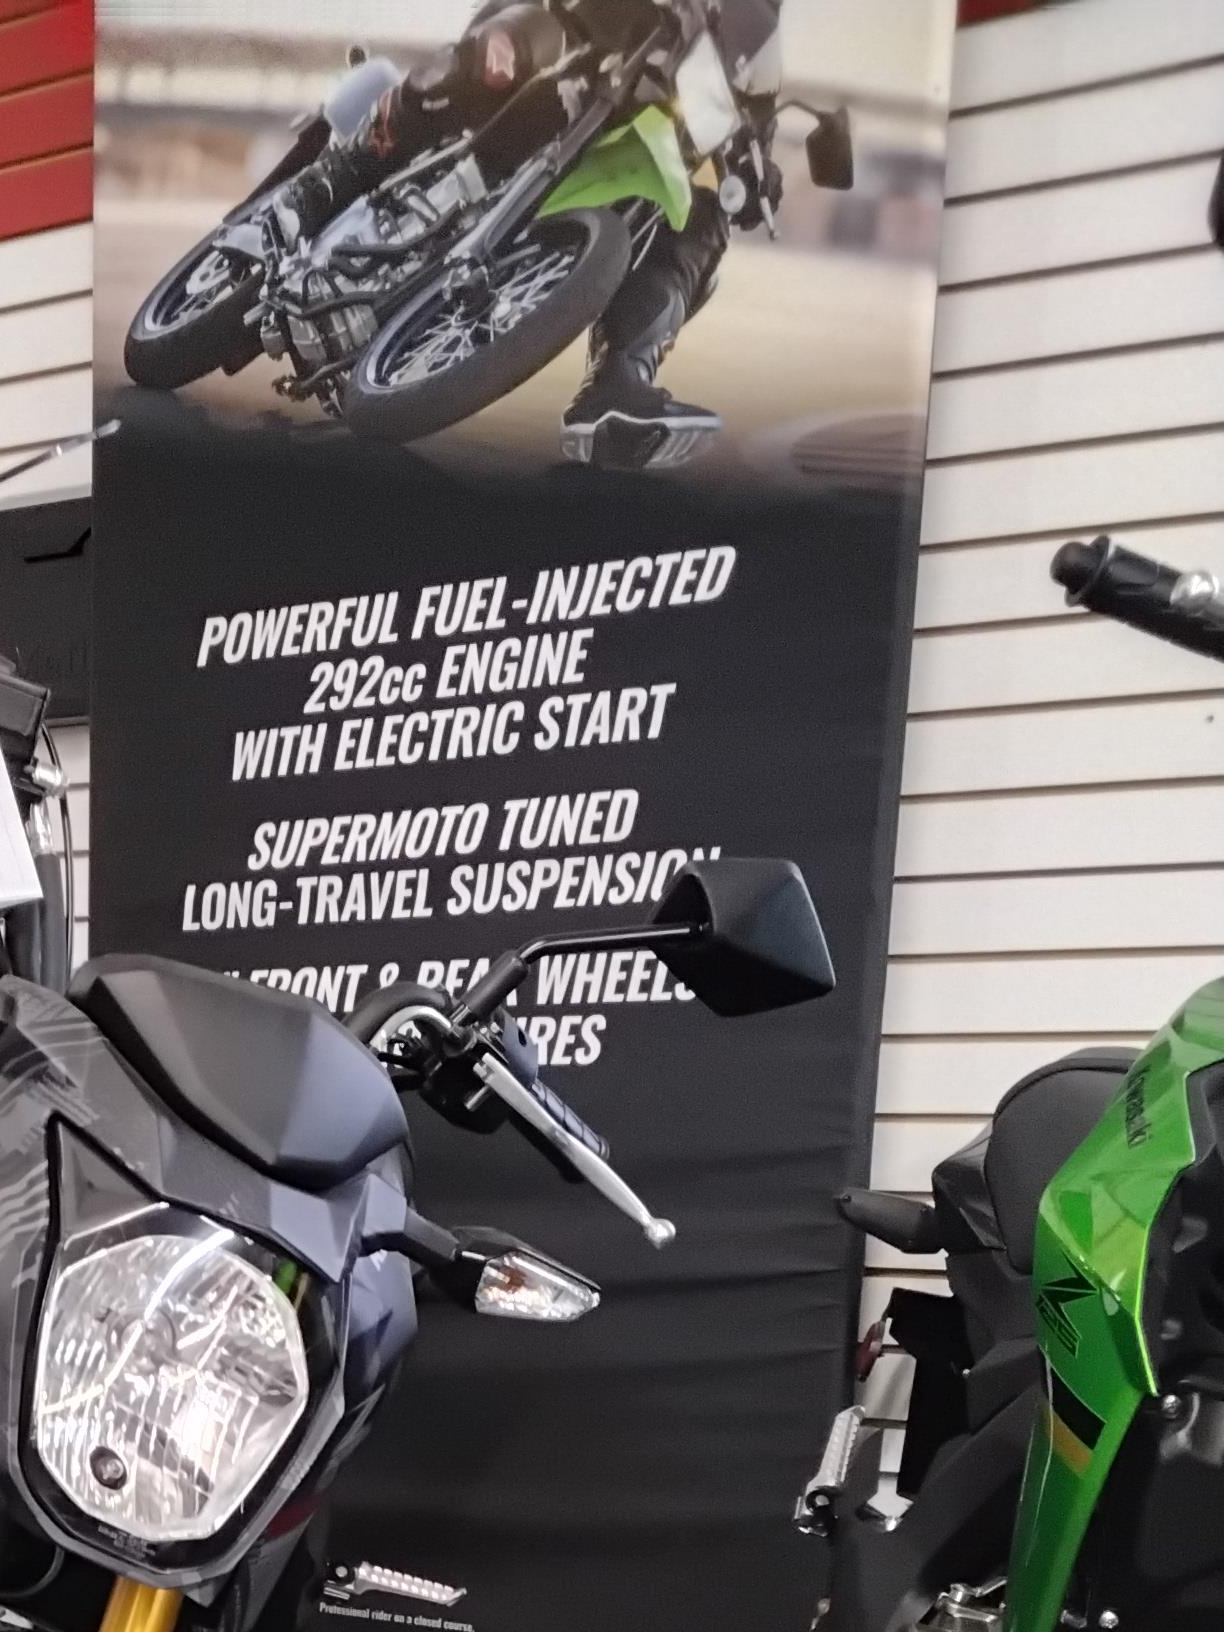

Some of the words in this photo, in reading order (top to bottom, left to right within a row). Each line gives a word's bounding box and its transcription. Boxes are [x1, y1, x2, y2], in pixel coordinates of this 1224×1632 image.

[196, 591, 399, 668] POWERFUL
[410, 545, 737, 640] FUEL-INJECTED
[303, 656, 427, 714] 292cc
[435, 627, 595, 699] ENGINE
[231, 723, 328, 782] WITH
[333, 701, 525, 771] ELECTRIC
[533, 682, 677, 751] START
[247, 803, 490, 871] SUPERMOTO
[498, 788, 639, 857] TUNED
[182, 868, 434, 932] LONG-TRAVEL
[446, 846, 722, 916] SUSPENSIO
[416, 957, 518, 1007] REA
[319, 1602, 370, 1619] Professional
[371, 1610, 392, 1622] rider
[394, 1614, 405, 1623] on
[406, 1615, 413, 1624] a
[414, 1615, 443, 1629] closed
[443, 1620, 475, 1632] course.
